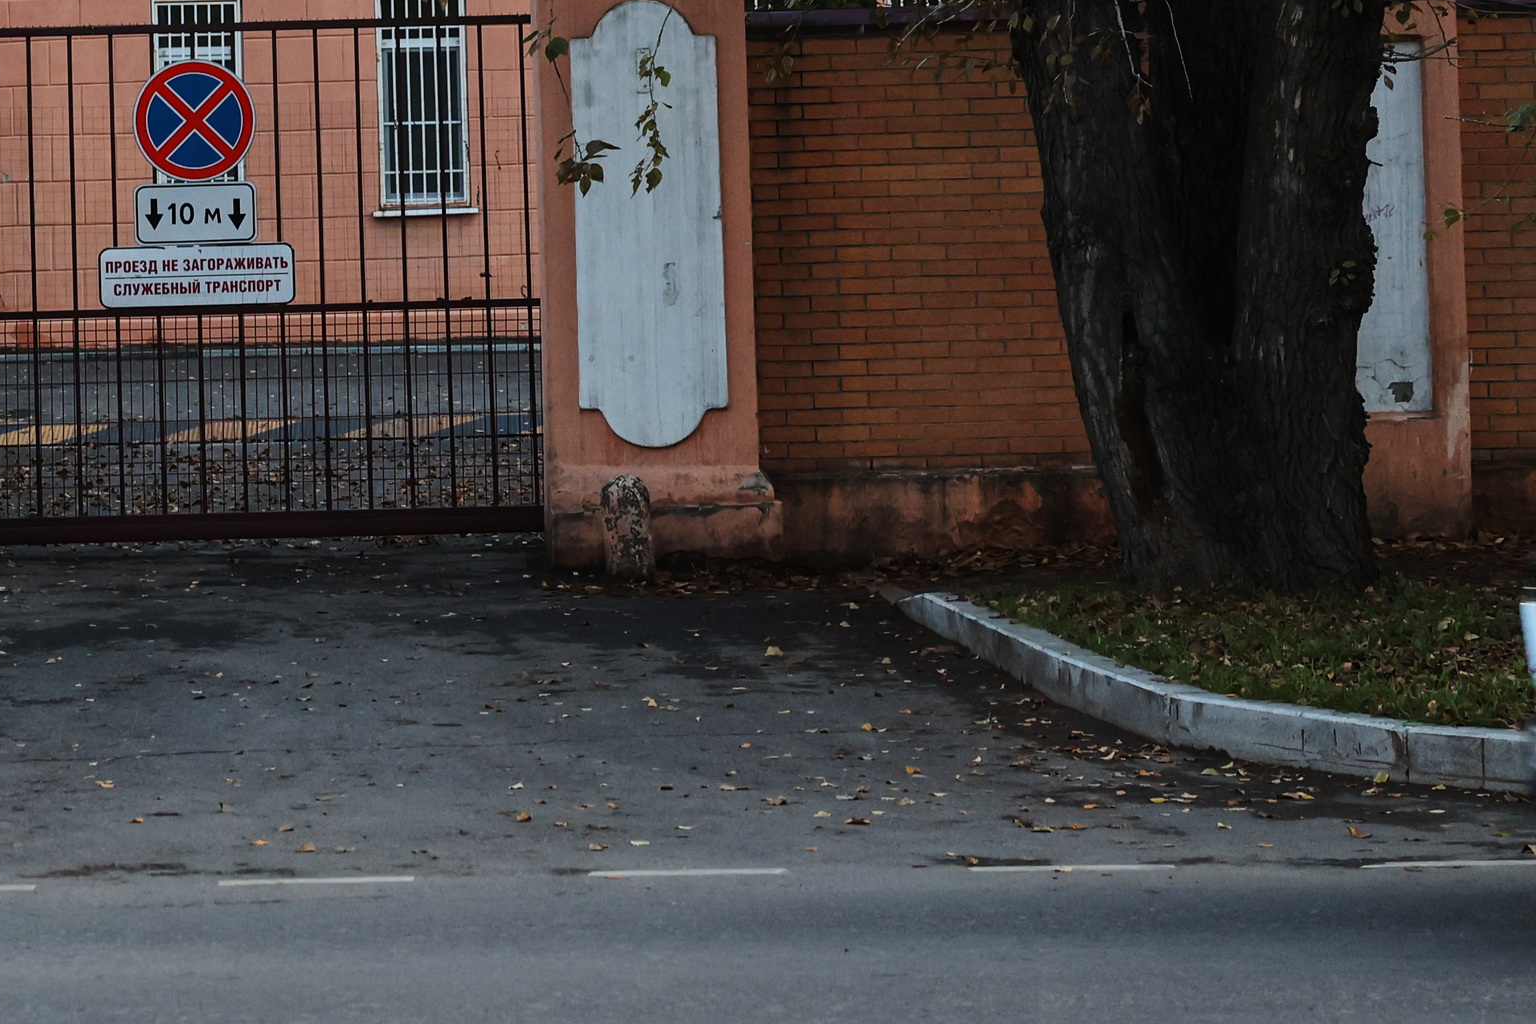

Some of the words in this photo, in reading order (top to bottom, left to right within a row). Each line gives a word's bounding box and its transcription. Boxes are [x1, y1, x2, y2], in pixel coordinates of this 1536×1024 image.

[167, 202, 195, 225] 10
[105, 260, 158, 274] ПРОЕЗД
[162, 259, 179, 273] НЕ
[182, 256, 289, 272] ЗАГОРАЖИВАТЬ
[113, 279, 202, 297] СЛУЖЕБНЫЙ
[204, 279, 282, 294] ТРАНСПОРТ
